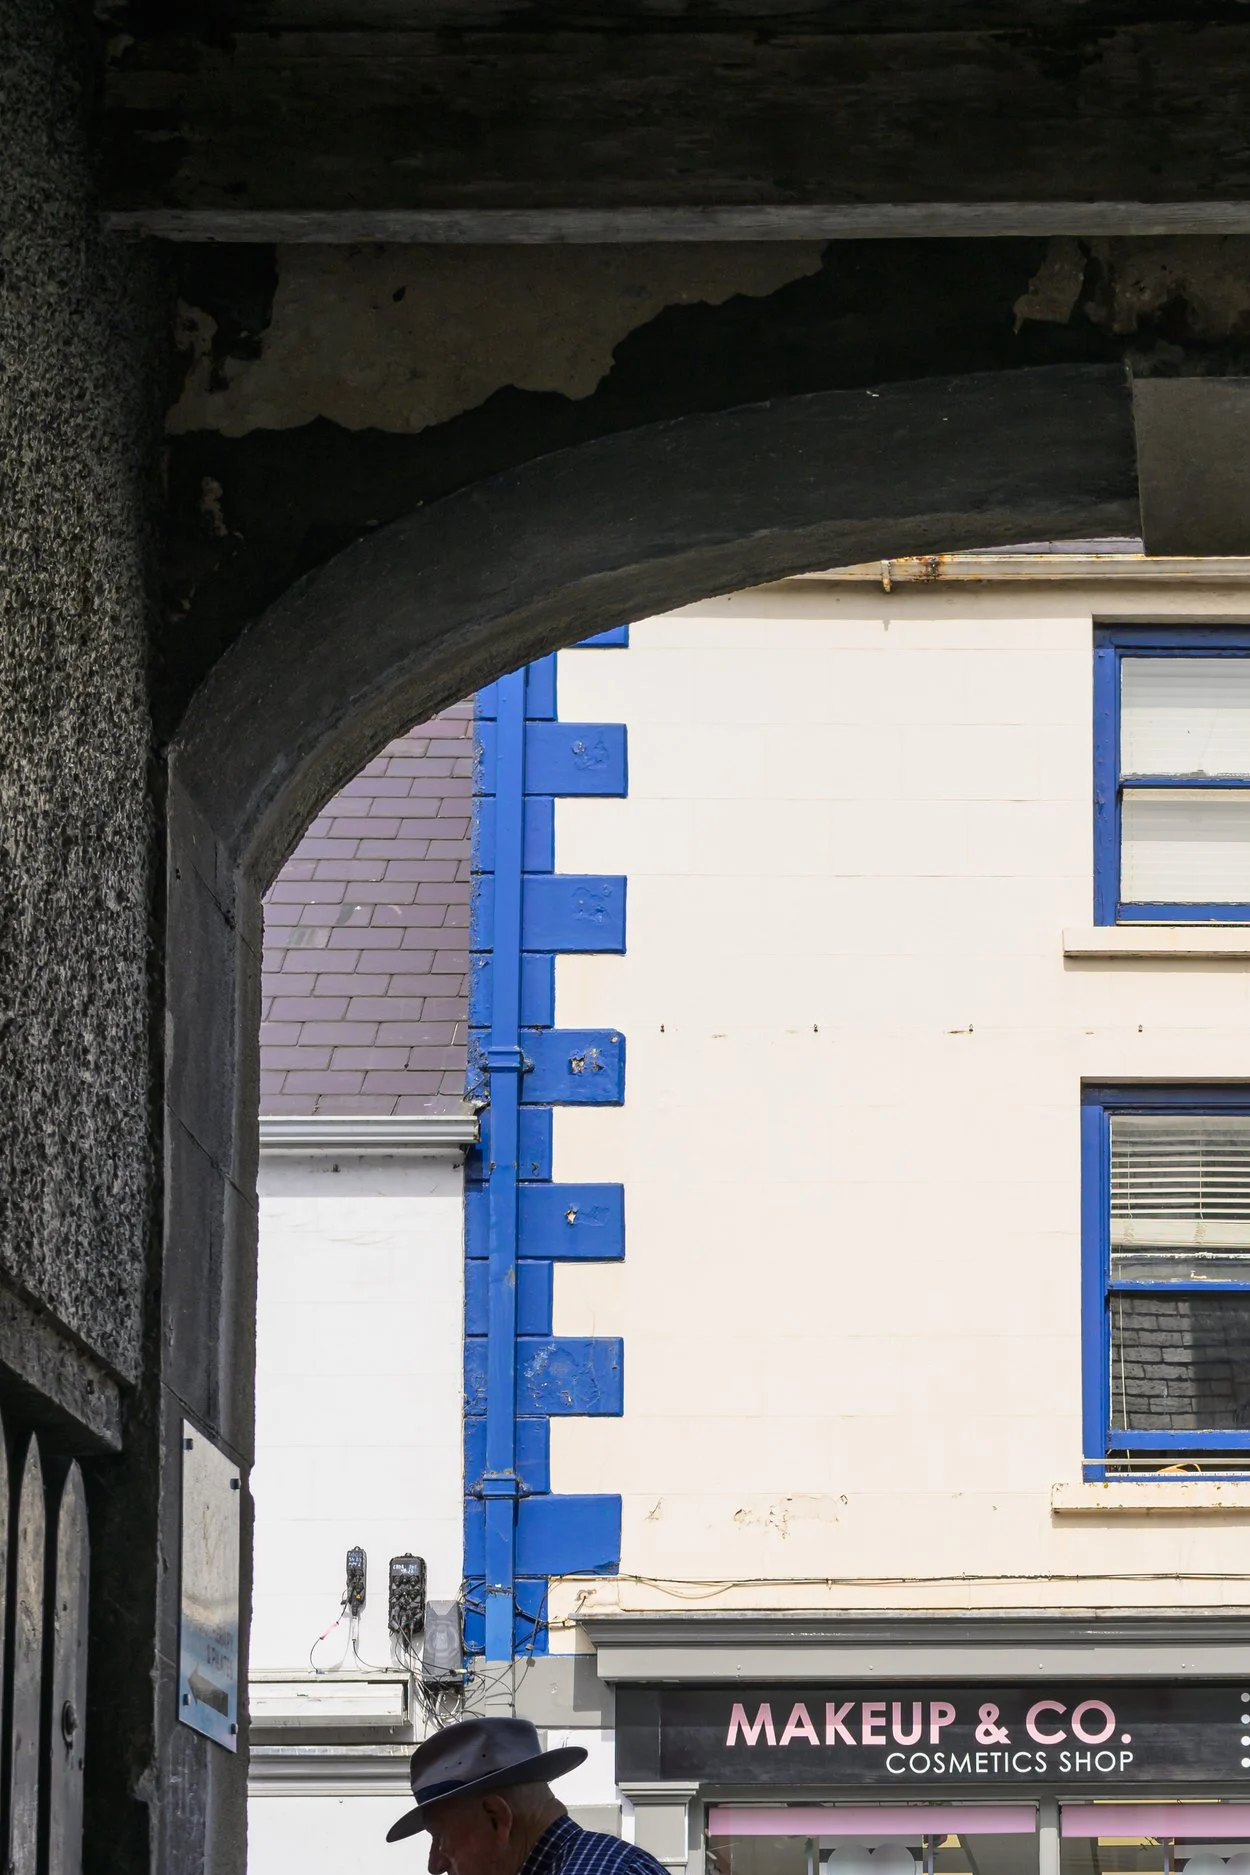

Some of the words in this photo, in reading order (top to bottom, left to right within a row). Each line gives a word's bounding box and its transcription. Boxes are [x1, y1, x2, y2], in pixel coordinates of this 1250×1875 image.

[726, 1701, 956, 1746] MAKEUP
[975, 1702, 1012, 1745] &
[1025, 1699, 1132, 1745] CO.
[885, 1751, 1047, 1774] COSMETICS
[1059, 1751, 1134, 1773] SHOP
